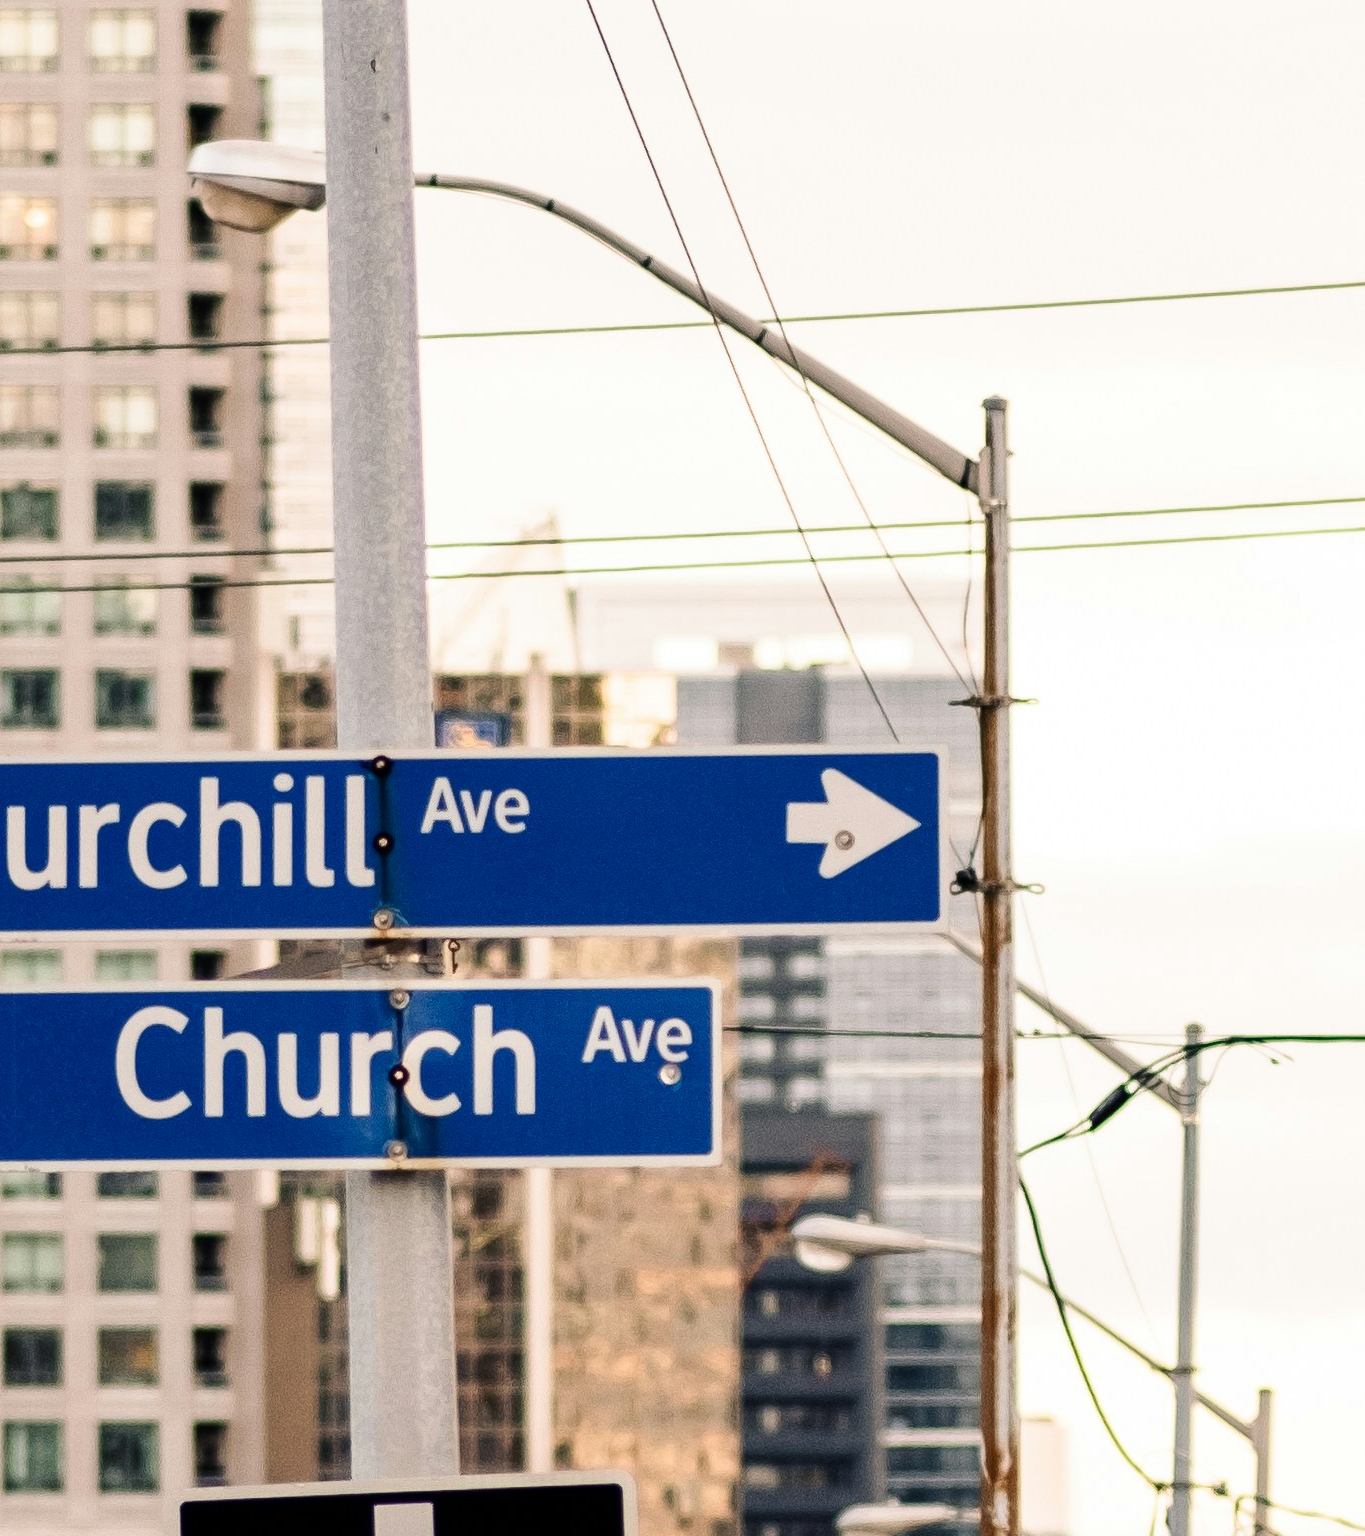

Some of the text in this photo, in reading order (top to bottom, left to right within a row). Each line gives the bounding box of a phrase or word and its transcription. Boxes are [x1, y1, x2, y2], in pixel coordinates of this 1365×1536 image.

[420, 776, 531, 834] Ave
[114, 1004, 693, 1119] Church Ave
